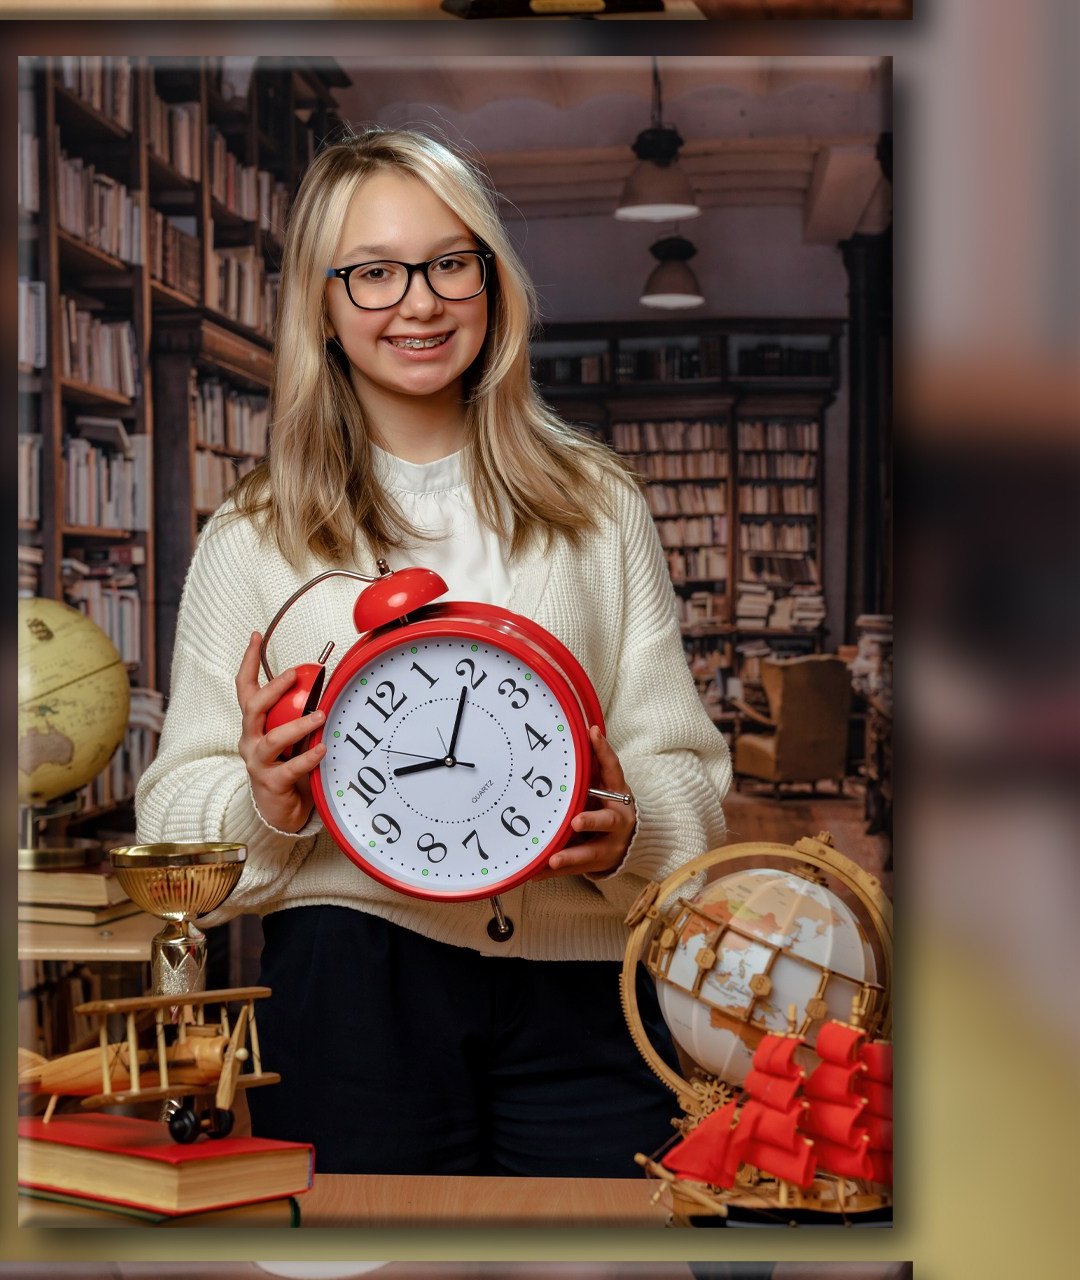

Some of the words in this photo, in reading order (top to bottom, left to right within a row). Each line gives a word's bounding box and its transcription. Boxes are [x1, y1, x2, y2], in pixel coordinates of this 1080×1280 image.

[410, 661, 439, 689] 1
[455, 658, 487, 690] 2
[365, 680, 408, 723] 12
[498, 677, 530, 709] 3
[343, 721, 384, 760] 11
[524, 722, 552, 751] 4
[346, 766, 387, 809] 10
[471, 779, 494, 804] QUARTZ
[521, 766, 553, 798] 5
[371, 813, 402, 844] 9
[500, 806, 531, 837] 6
[416, 832, 448, 864] 8
[461, 829, 489, 860] 7
